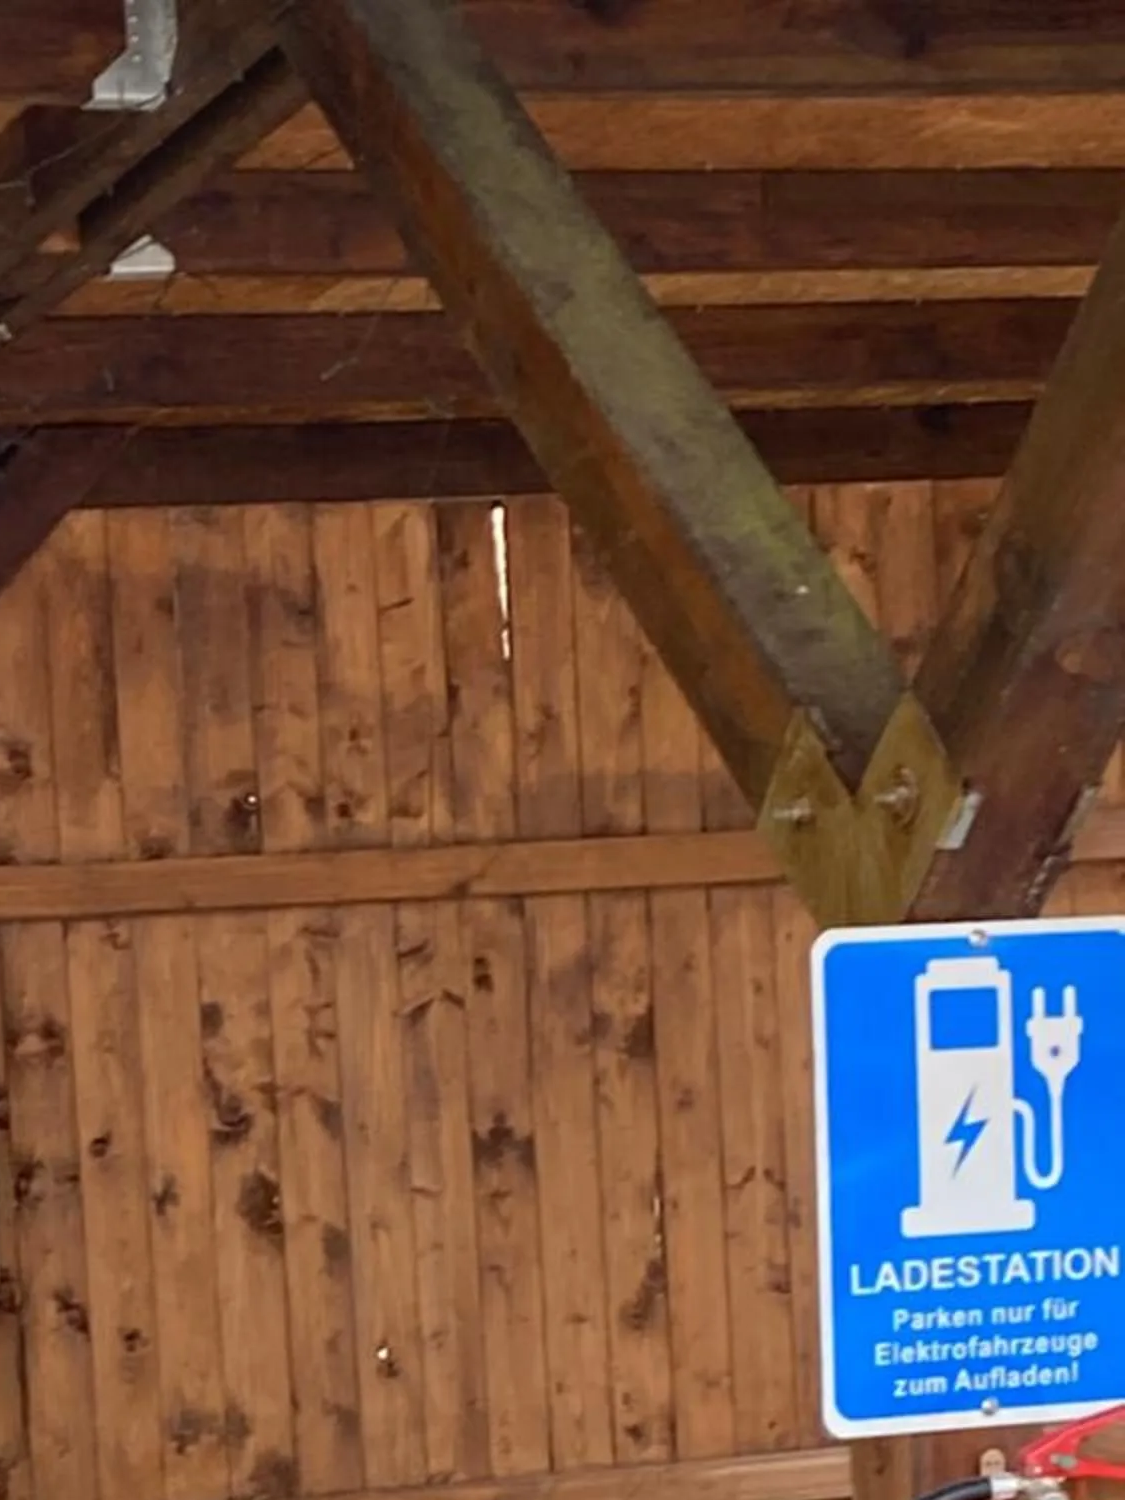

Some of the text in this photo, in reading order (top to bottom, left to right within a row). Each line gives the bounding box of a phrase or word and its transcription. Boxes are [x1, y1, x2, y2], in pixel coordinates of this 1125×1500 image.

[850, 1246, 1120, 1296] LADESTATION
[892, 1298, 1080, 1332] Parken nur für
[875, 1331, 1099, 1367] Elektrofahrzeuge
[892, 1361, 1080, 1397] zum Aufladen!
